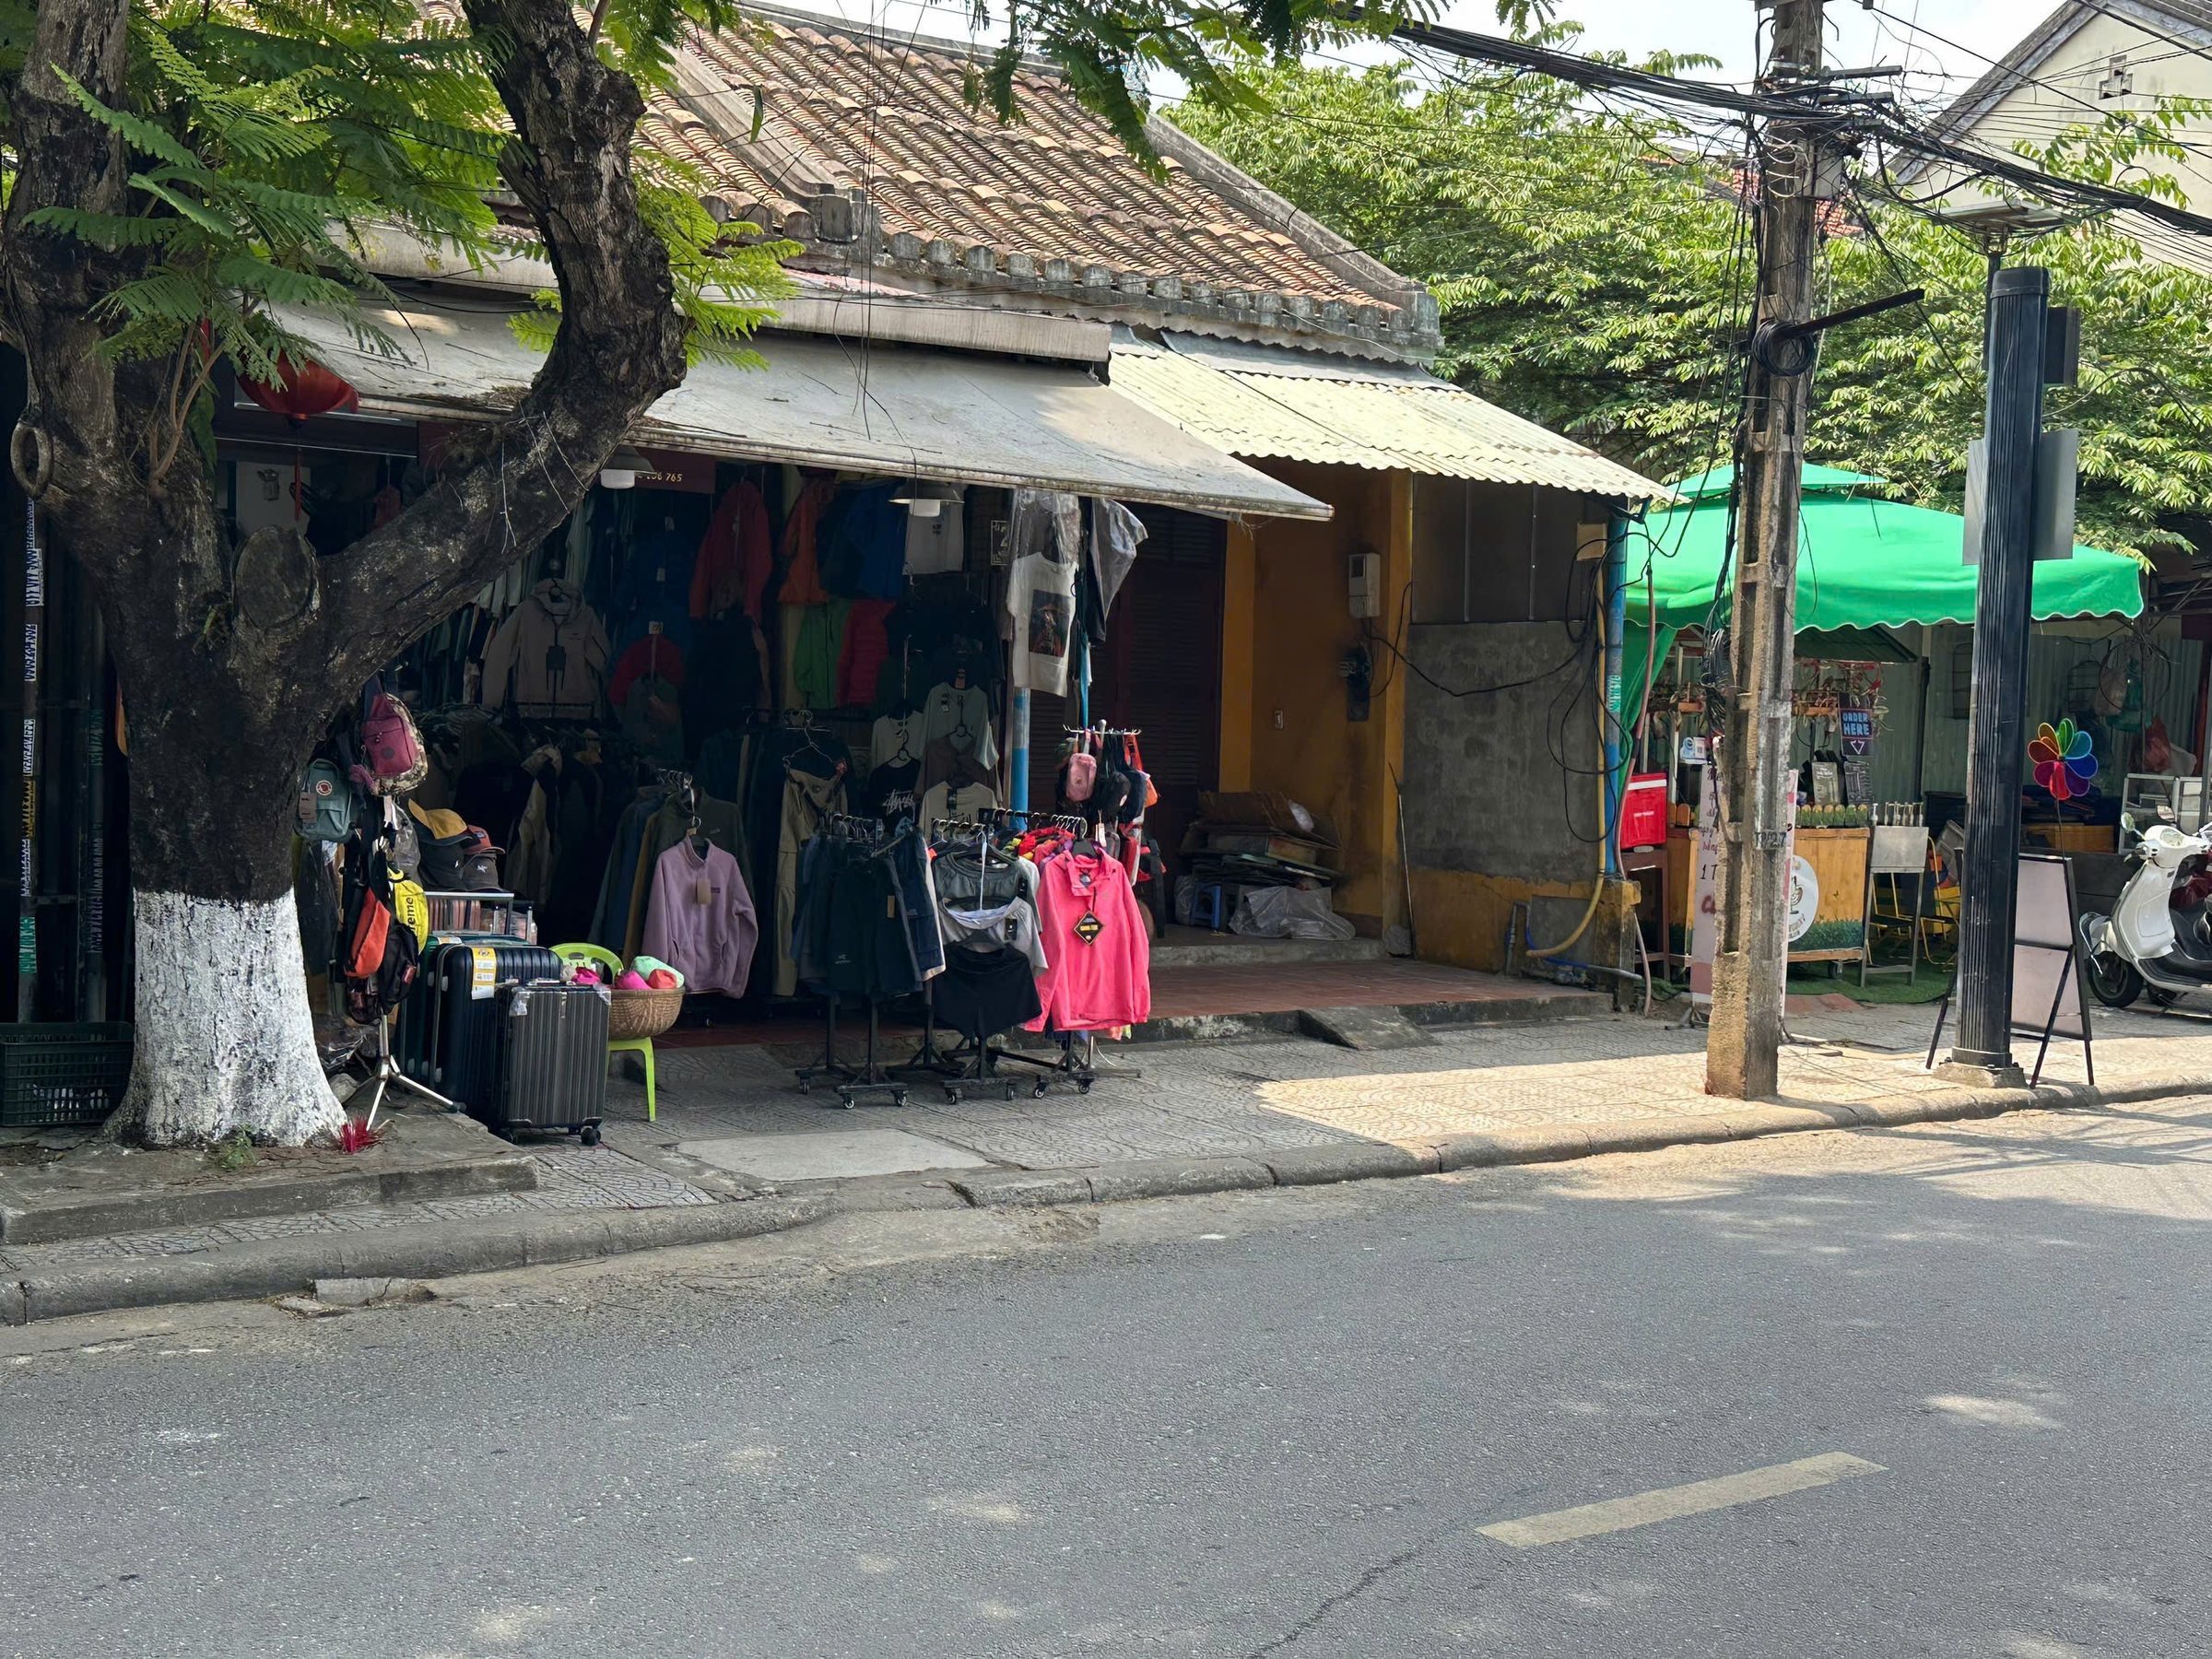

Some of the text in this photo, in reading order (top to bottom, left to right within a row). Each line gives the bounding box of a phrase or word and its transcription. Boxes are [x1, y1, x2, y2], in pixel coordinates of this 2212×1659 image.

[665, 472, 683, 482] 765
[1842, 712, 1868, 723] ORDER
[1843, 723, 1870, 735] HERE
